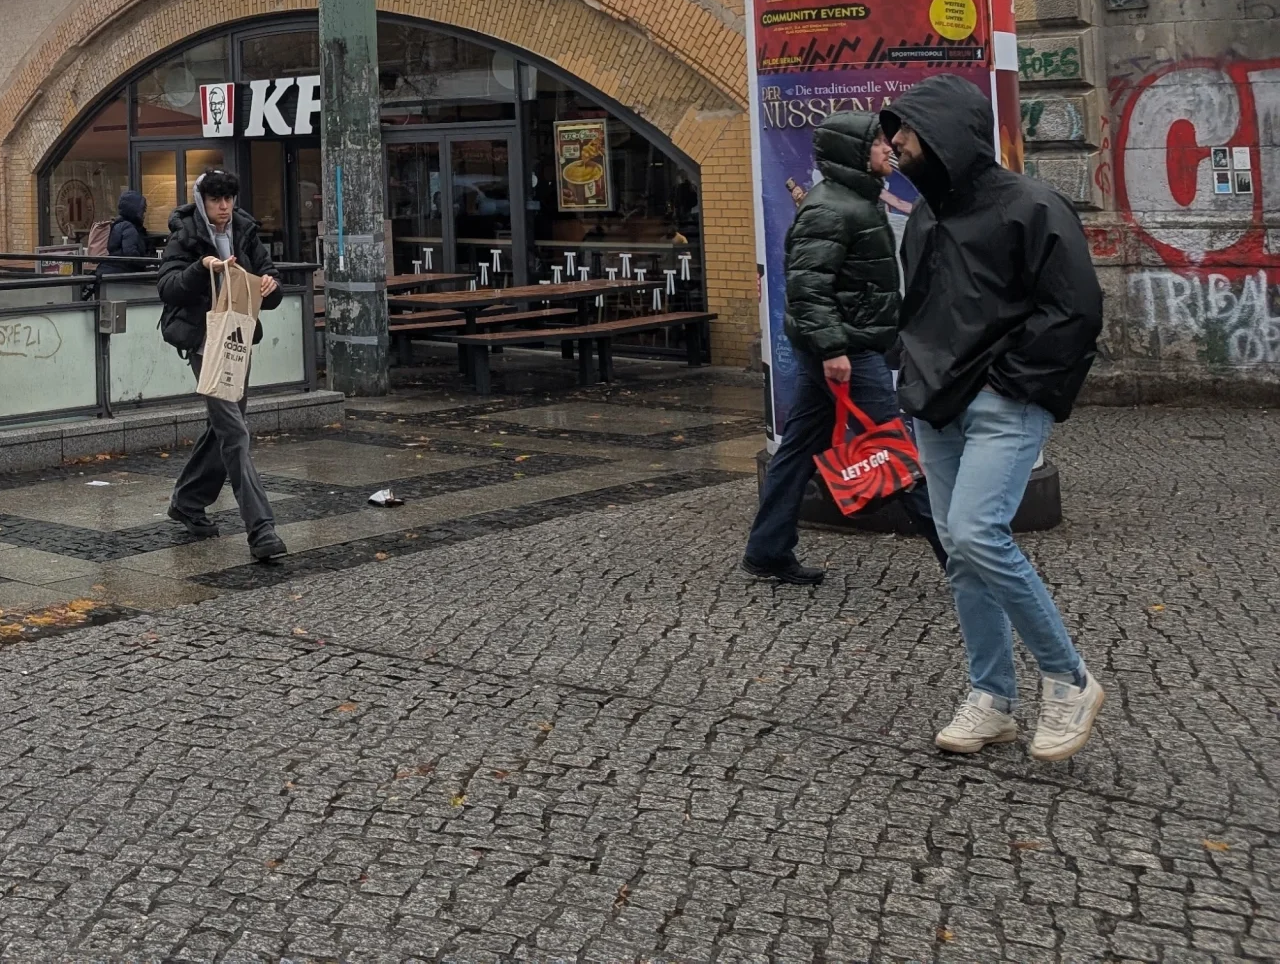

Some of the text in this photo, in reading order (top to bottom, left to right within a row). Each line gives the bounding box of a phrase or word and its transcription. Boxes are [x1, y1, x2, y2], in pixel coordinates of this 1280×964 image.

[763, 6, 866, 24] COMMUNITY EVENTS
[891, 50, 943, 58] SPORTMETROPOLE
[762, 86, 781, 101] DER
[795, 85, 812, 96] Die
[814, 81, 882, 95] traditionelle
[244, 75, 320, 136] KF
[841, 449, 890, 482] LET'S GO!
